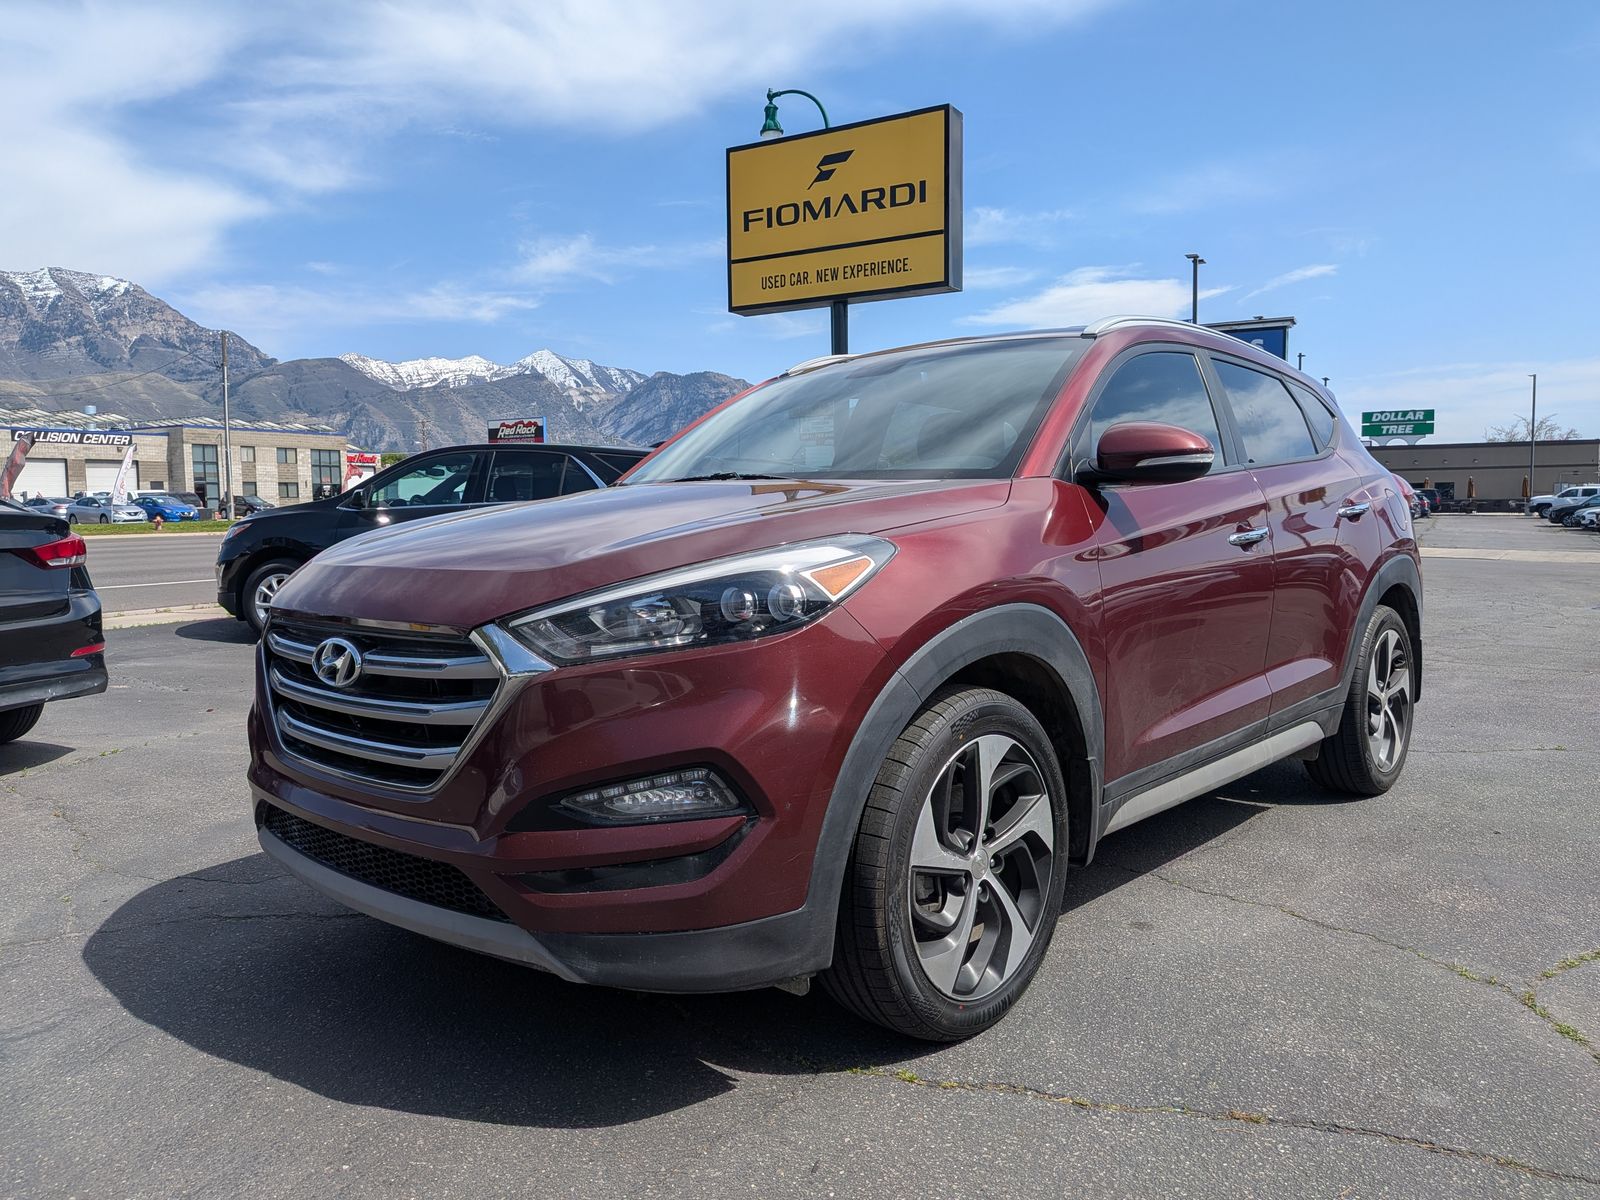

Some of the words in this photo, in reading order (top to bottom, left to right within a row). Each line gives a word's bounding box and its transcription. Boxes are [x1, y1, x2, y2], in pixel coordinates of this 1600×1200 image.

[743, 180, 927, 232] FIOMARDI
[761, 274, 786, 290] USED
[789, 271, 813, 286] CAR.
[816, 267, 839, 284] NEW
[843, 257, 912, 280] EXPERIENCE.
[1371, 411, 1425, 422] DOLLAR
[497, 426, 516, 438] Red
[515, 424, 537, 434] Rock
[1381, 425, 1414, 435] TREE
[83, 434, 130, 445] CENTER
